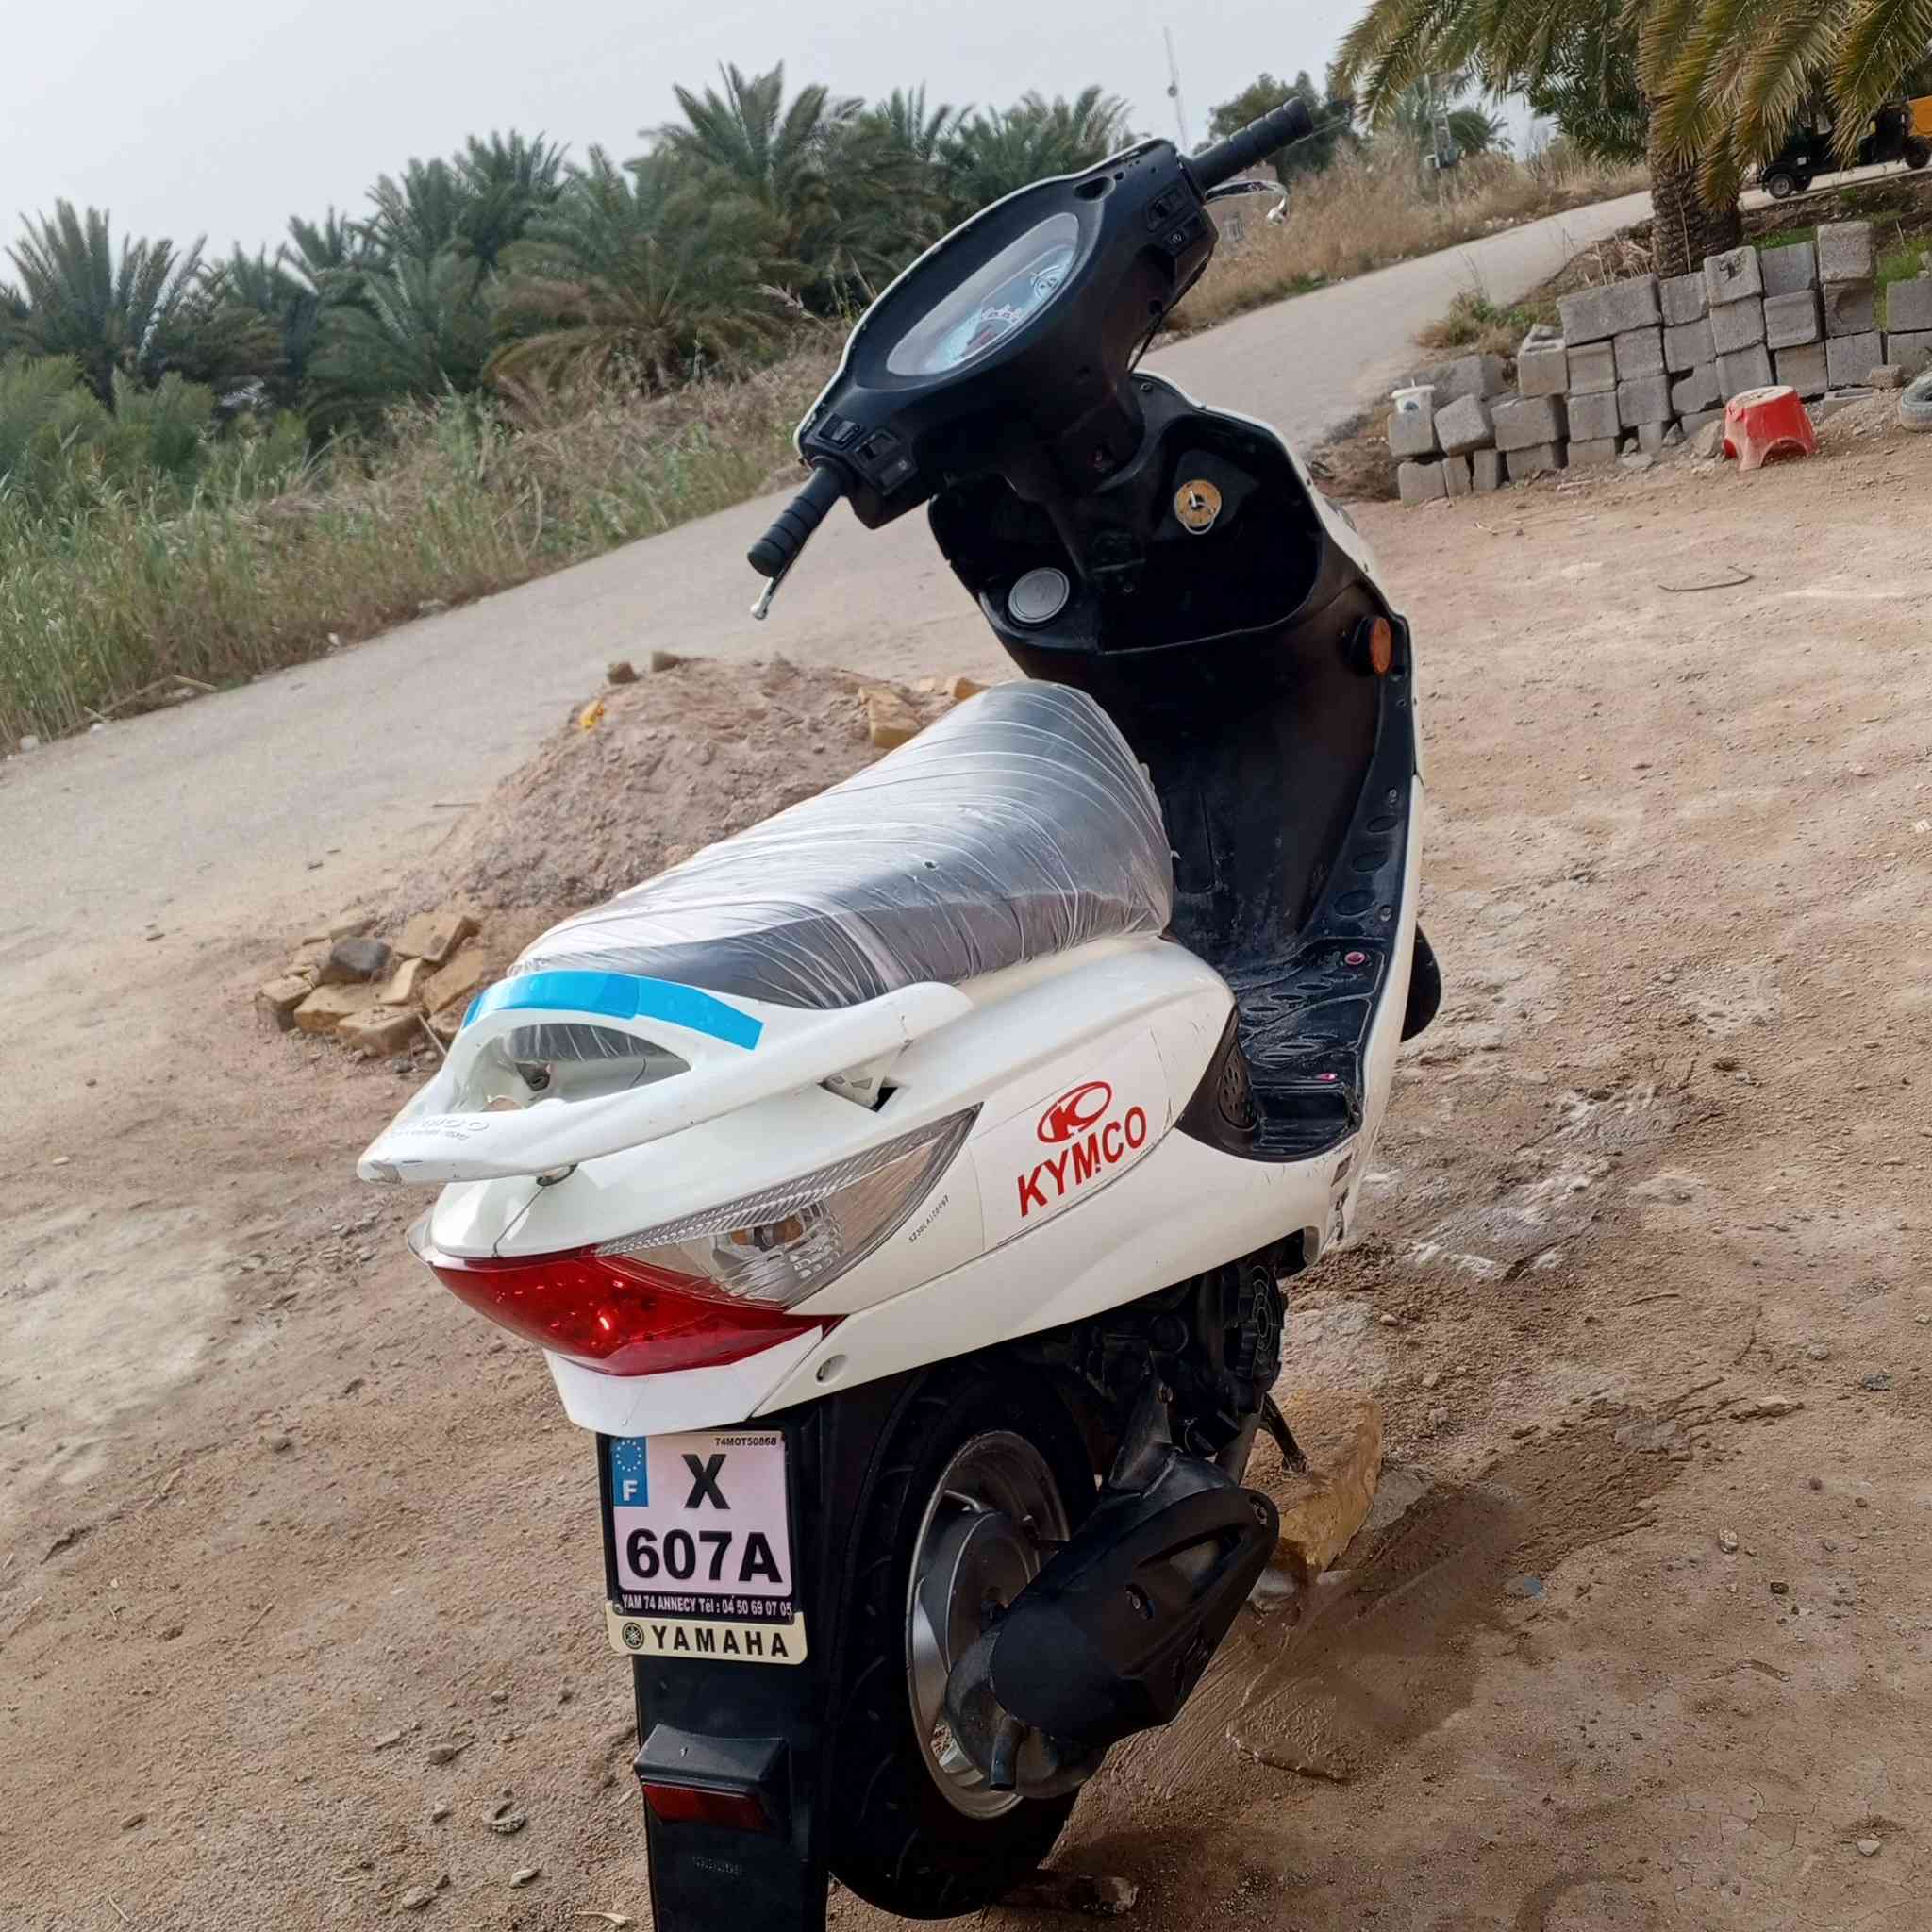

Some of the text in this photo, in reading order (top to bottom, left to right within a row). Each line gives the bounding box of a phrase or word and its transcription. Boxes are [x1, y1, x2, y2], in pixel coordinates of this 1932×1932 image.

[1017, 1106, 1147, 1218] KYMCO
[714, 1437, 777, 1447] 74MOT50868
[622, 1479, 638, 1502] F
[682, 1454, 732, 1510] X
[626, 1527, 784, 1584] 607A
[622, 1594, 642, 1608] YAM
[644, 1596, 657, 1610] 74
[658, 1596, 697, 1612] ANNECY
[722, 1600, 734, 1615] 04
[737, 1601, 749, 1615] 50
[751, 1601, 763, 1616] 69
[765, 1602, 778, 1616] 07
[651, 1625, 789, 1657] YAMAHA
